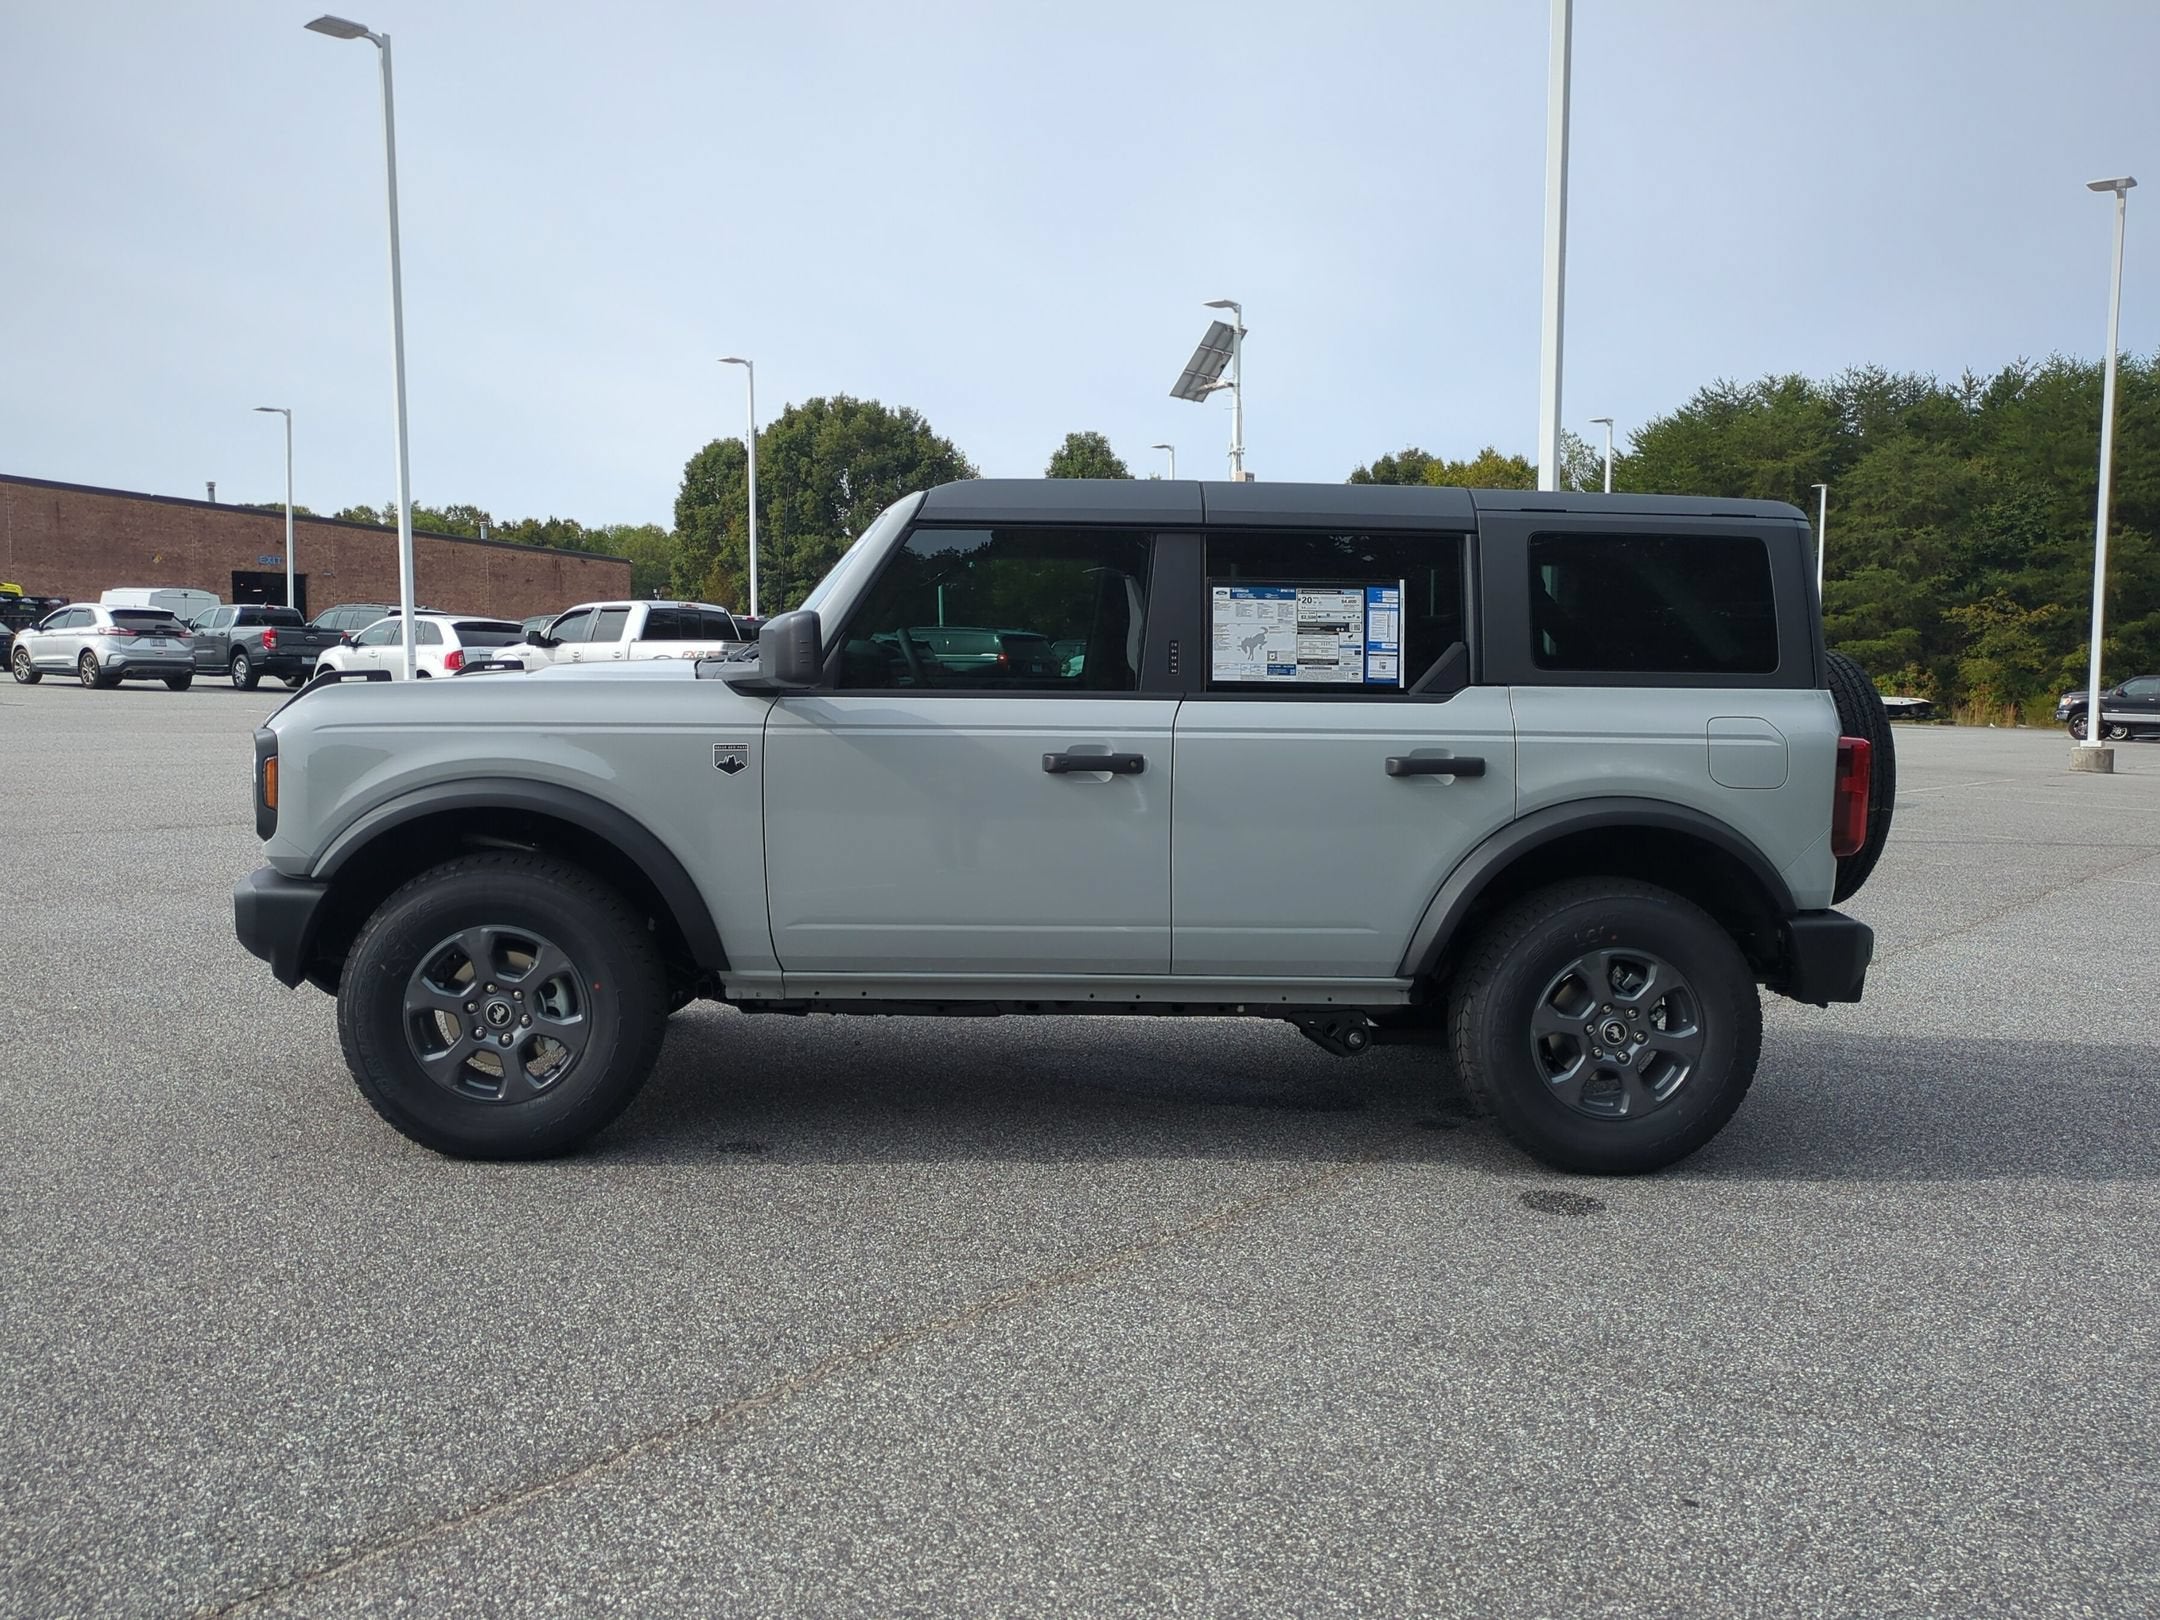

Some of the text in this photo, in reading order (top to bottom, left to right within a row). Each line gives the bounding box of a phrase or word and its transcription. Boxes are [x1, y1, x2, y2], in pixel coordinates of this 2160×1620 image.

[259, 555, 281, 565] EXIT
[1301, 596, 1313, 604] 20
[682, 650, 705, 659] FX2
